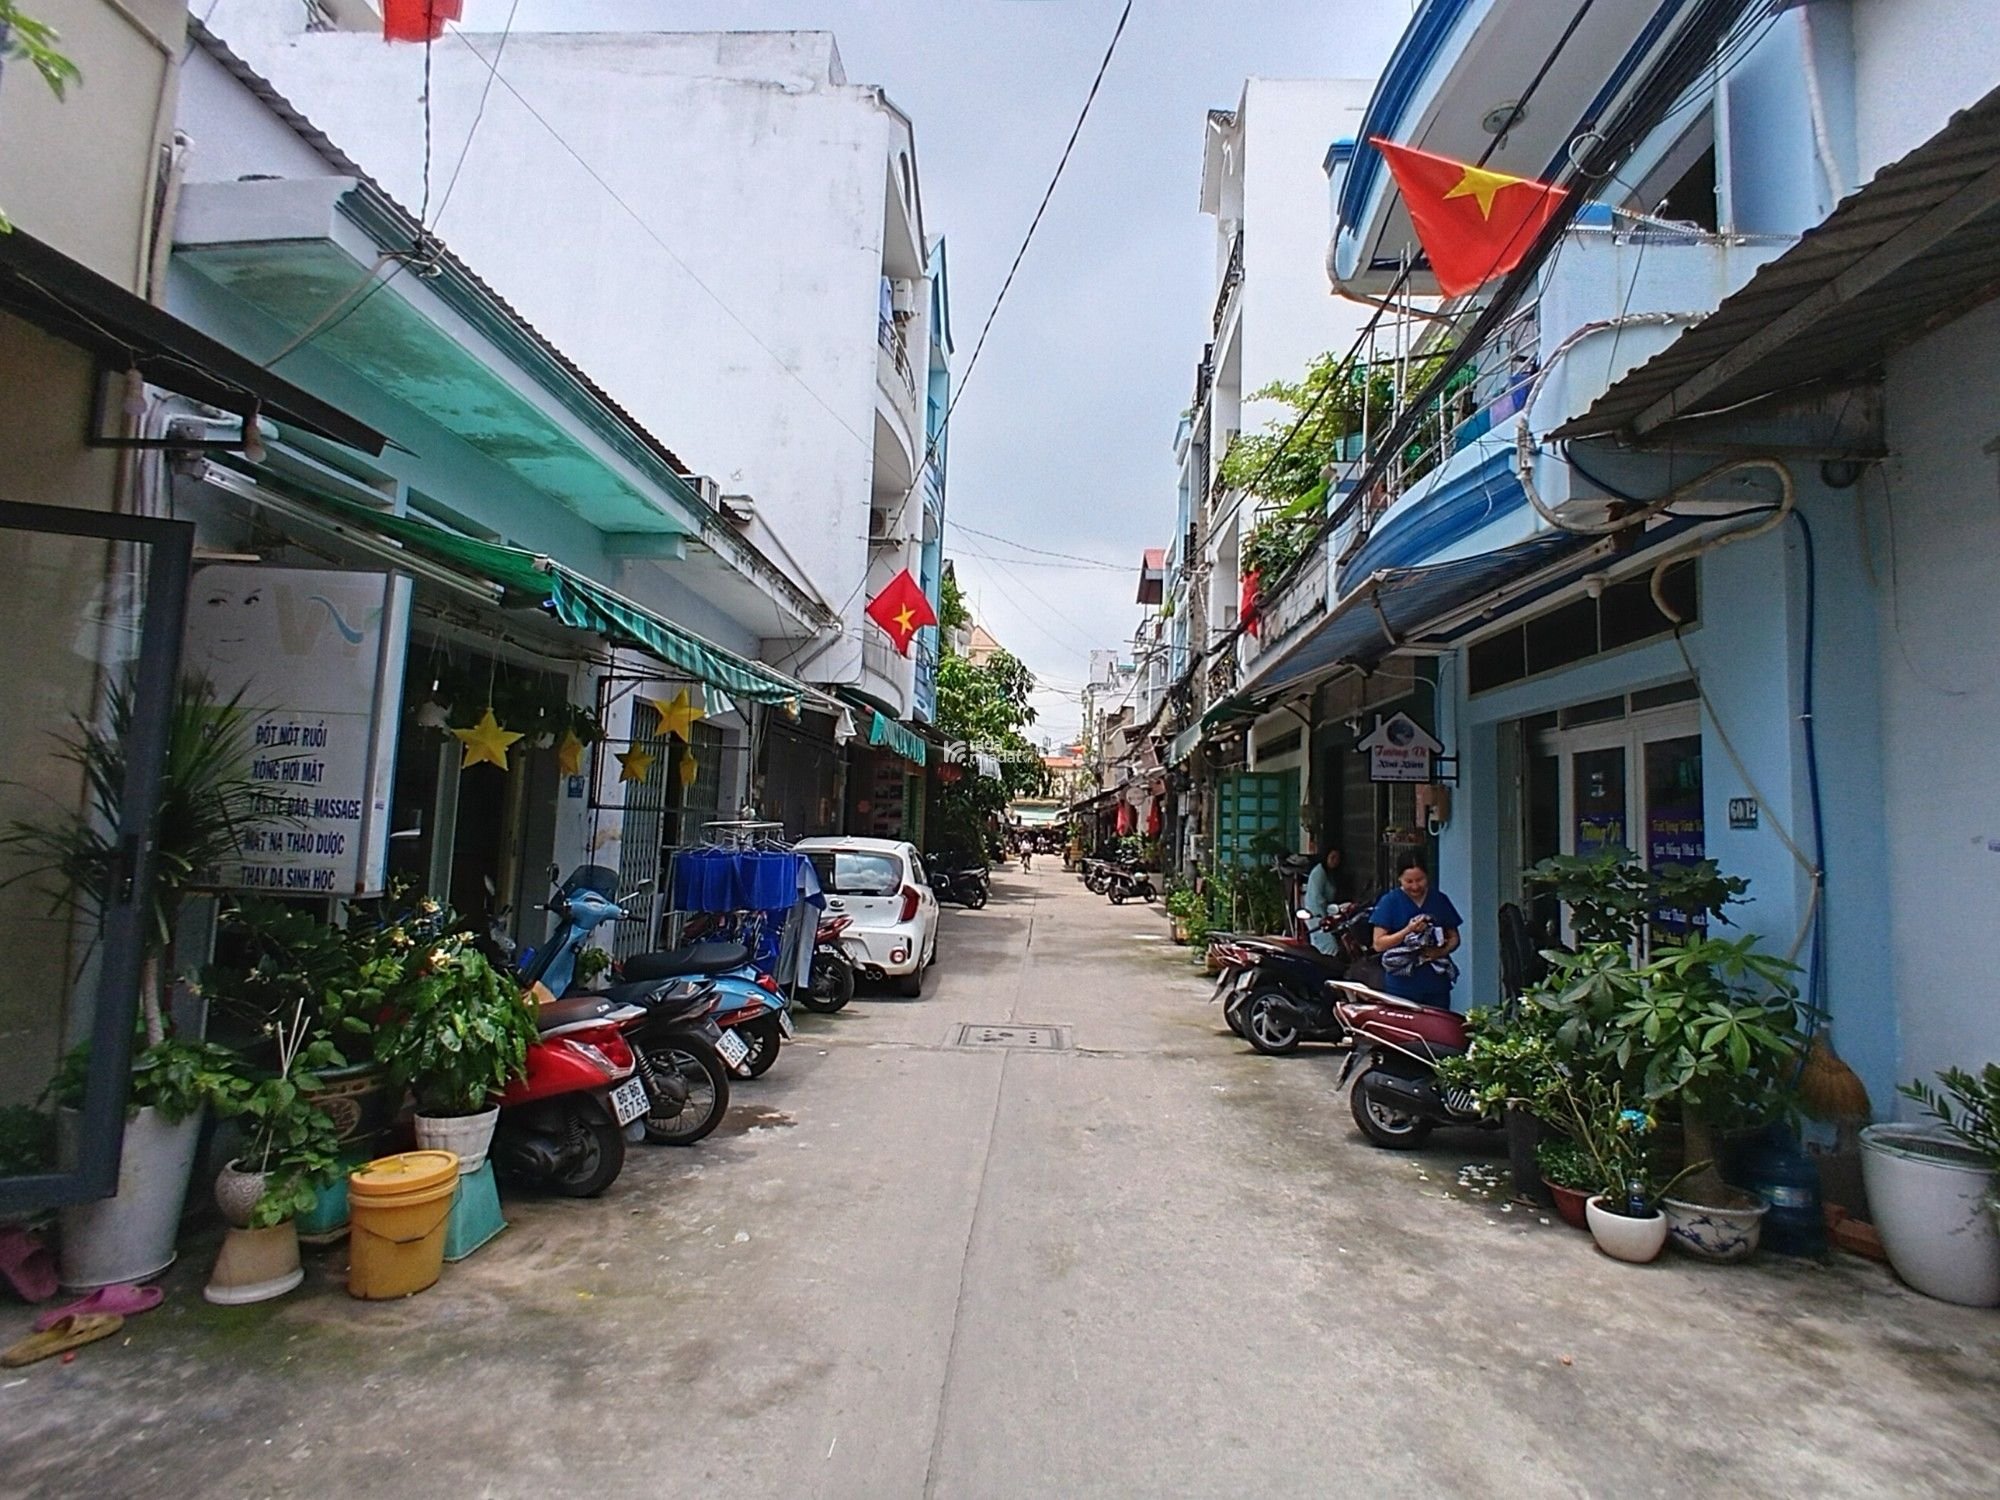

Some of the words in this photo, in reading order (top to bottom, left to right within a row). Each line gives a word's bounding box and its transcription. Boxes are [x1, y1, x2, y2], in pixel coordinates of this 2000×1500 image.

[314, 798, 362, 820] MASSAGE
[241, 865, 267, 887] THAY
[270, 867, 284, 888] DA
[286, 868, 311, 889] SINH
